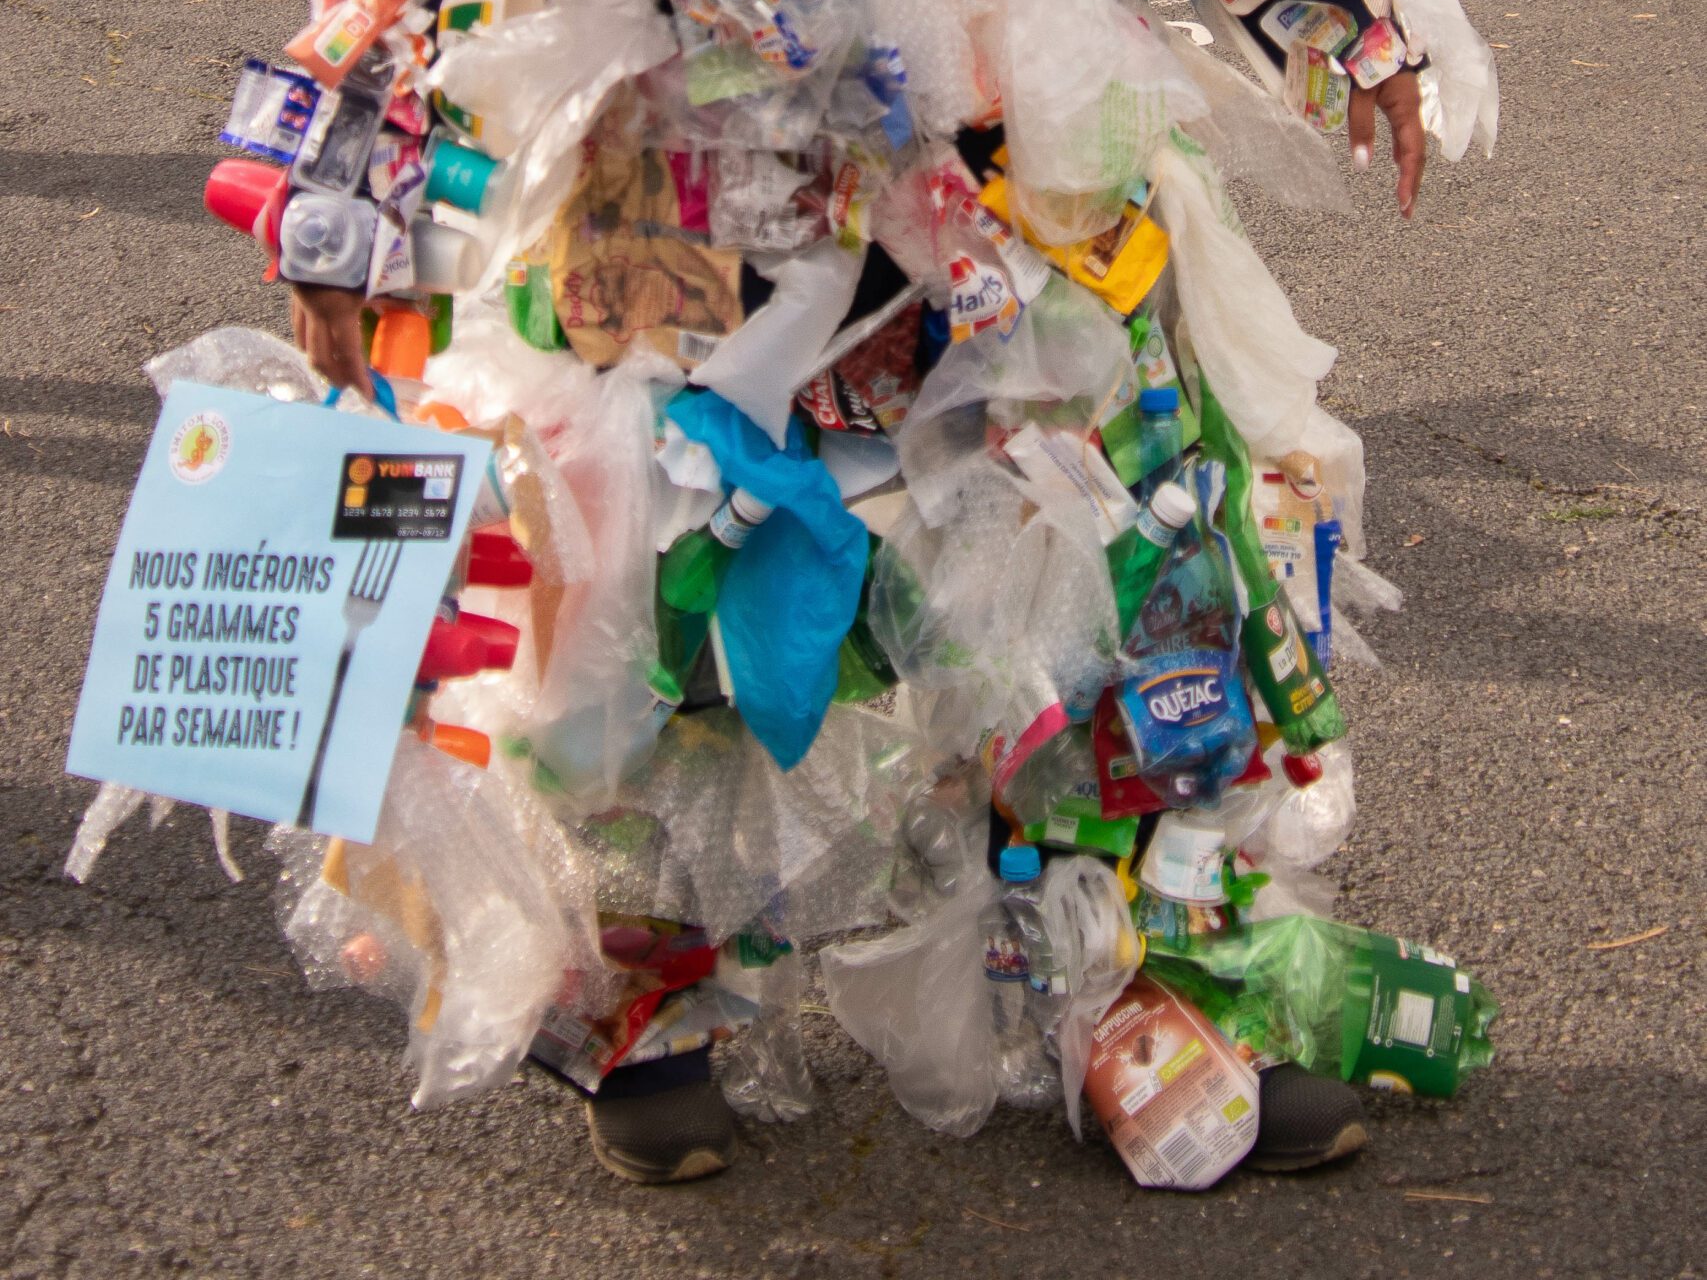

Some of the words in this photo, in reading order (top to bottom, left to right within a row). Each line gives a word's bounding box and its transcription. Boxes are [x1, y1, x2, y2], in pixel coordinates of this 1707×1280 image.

[128, 550, 198, 591] NOUS
[201, 539, 336, 595] INGÉRONS
[144, 602, 161, 641] 5
[167, 603, 301, 644] GRAMMES
[133, 654, 164, 694] DE
[168, 655, 300, 703] PLASTIQUE
[1149, 679, 1223, 723] QUÉZAC
[117, 706, 167, 747] PAR
[172, 707, 288, 750] SEMAINE
[288, 712, 301, 750] !
